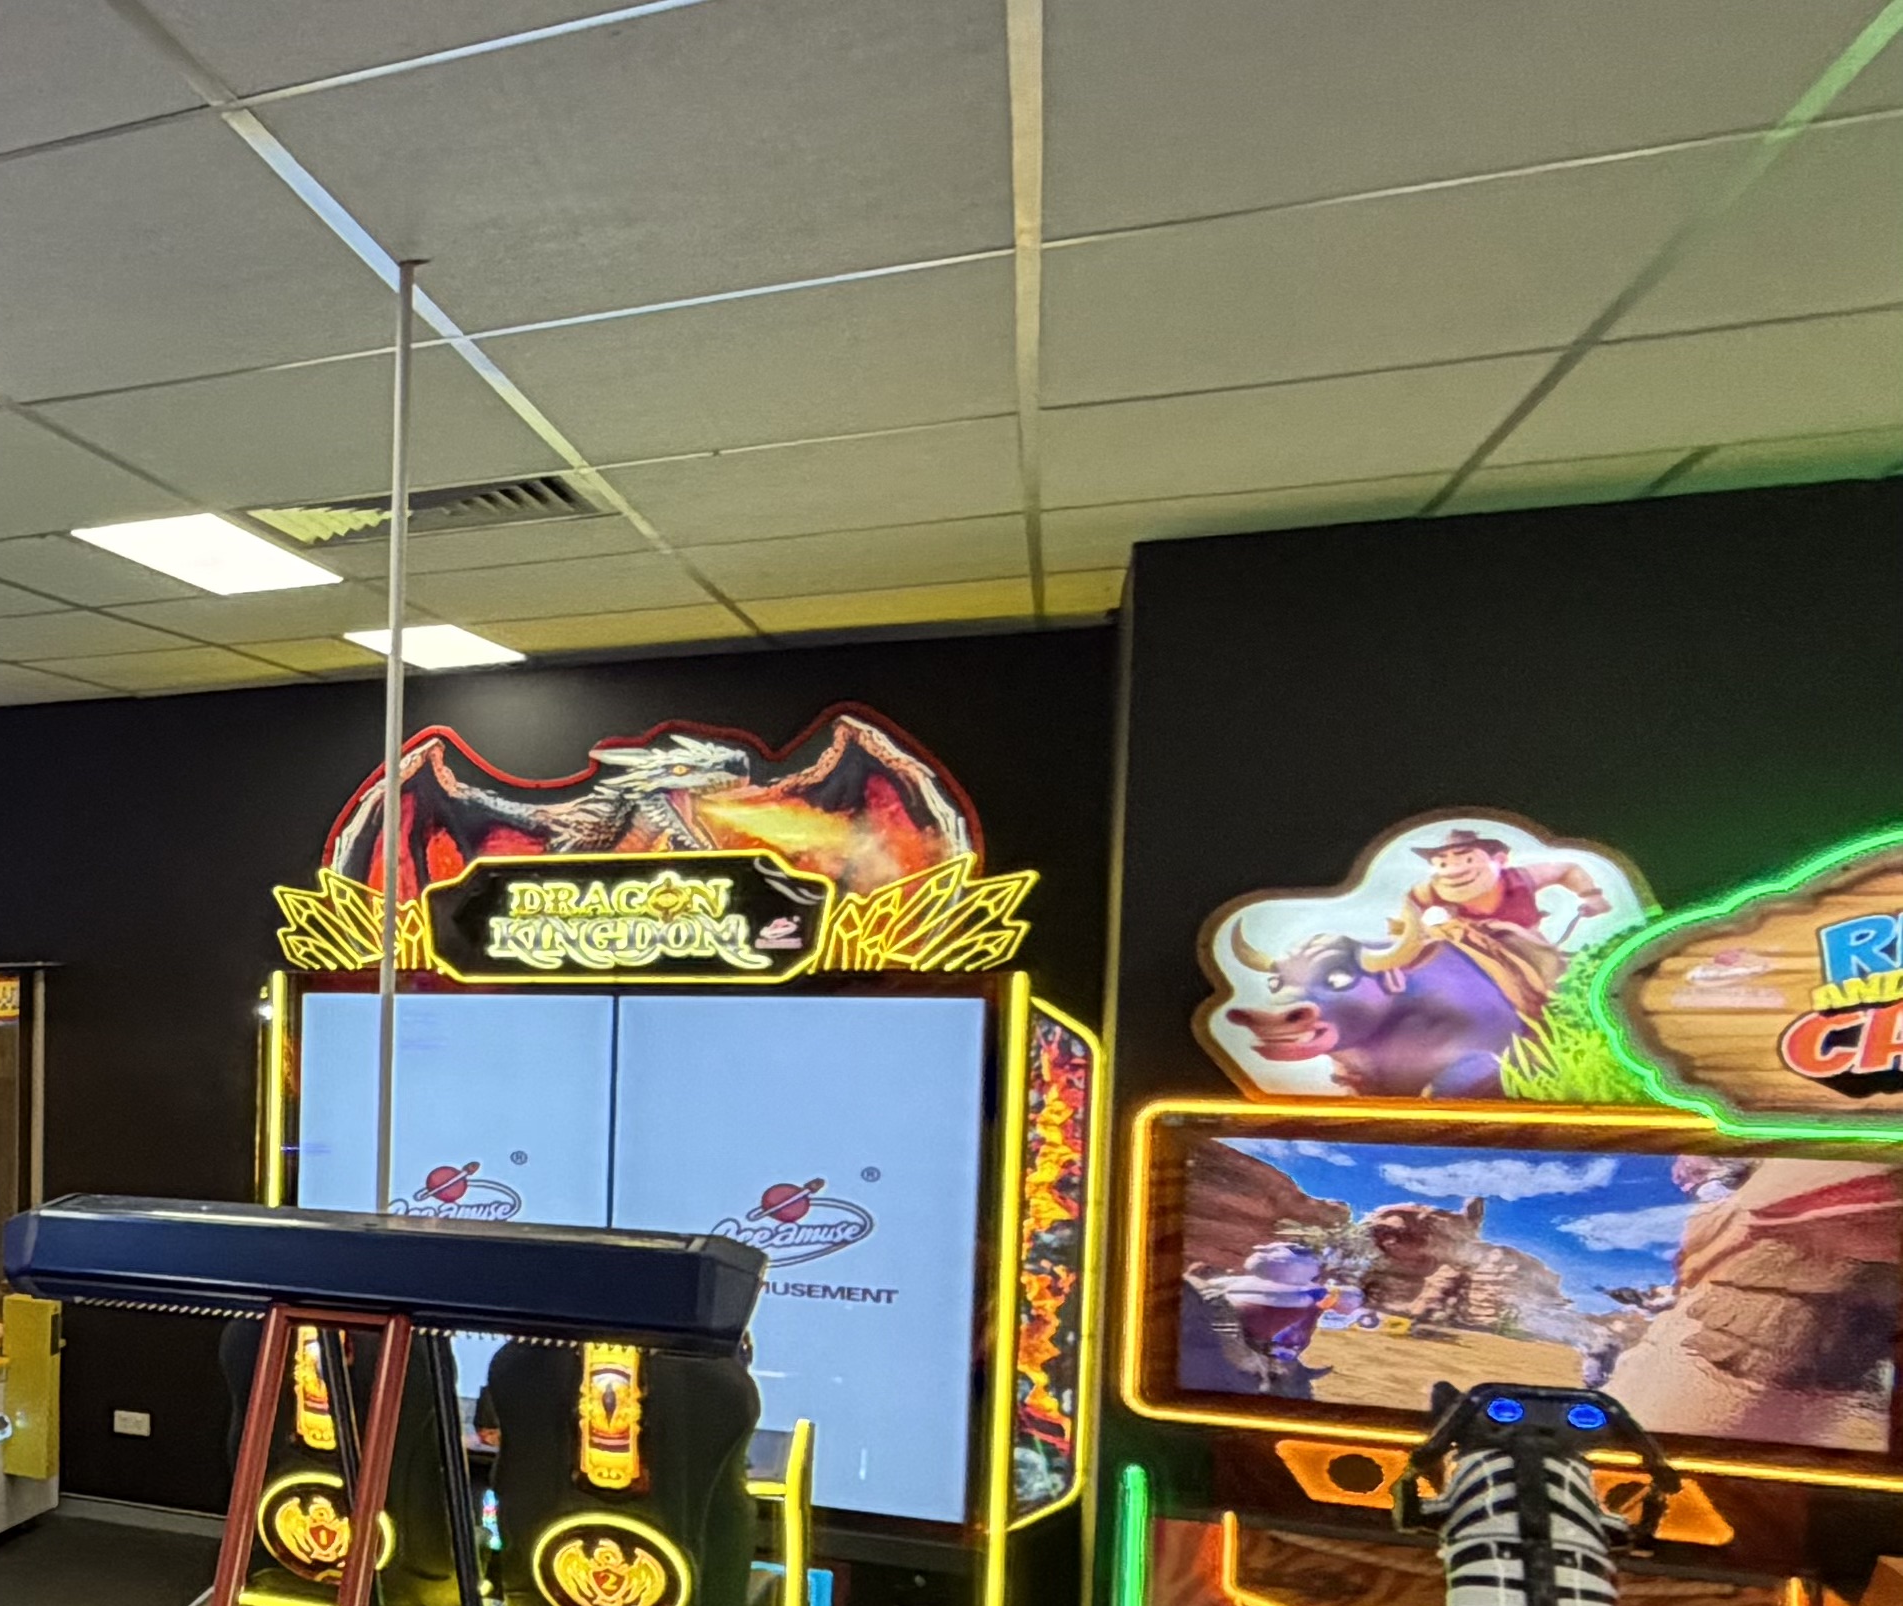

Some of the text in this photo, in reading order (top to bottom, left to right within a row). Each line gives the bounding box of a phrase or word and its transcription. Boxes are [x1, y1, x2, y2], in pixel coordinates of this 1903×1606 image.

[508, 873, 734, 920] DRAGON
[487, 915, 772, 969] KINGDOM
[762, 1280, 899, 1304] USEMENT
[601, 1572, 618, 1591] 2
